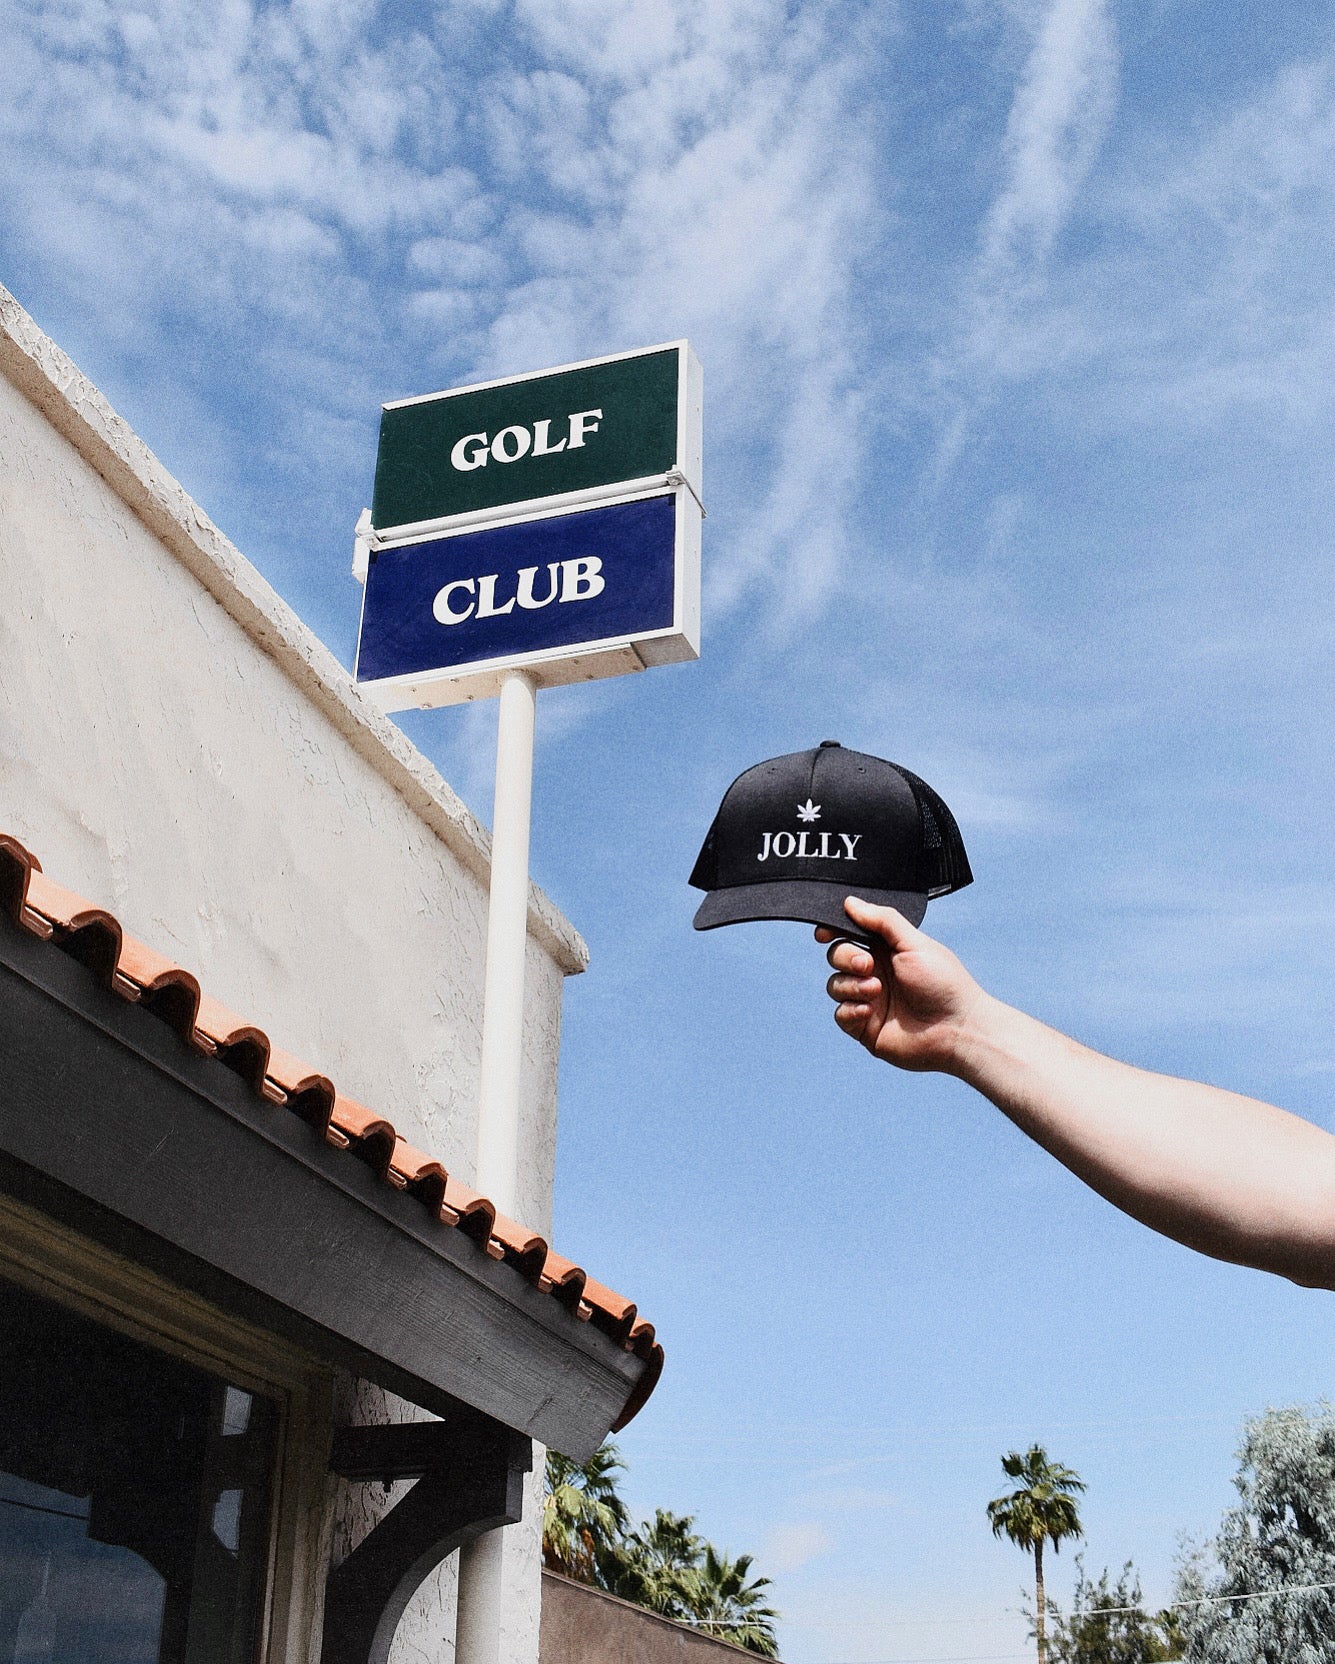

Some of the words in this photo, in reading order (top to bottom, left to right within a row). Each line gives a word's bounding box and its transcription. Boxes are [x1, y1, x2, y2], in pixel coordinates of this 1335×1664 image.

[450, 408, 603, 472] GOLF
[432, 556, 606, 625] CLUB
[757, 831, 862, 862] JOLLY
